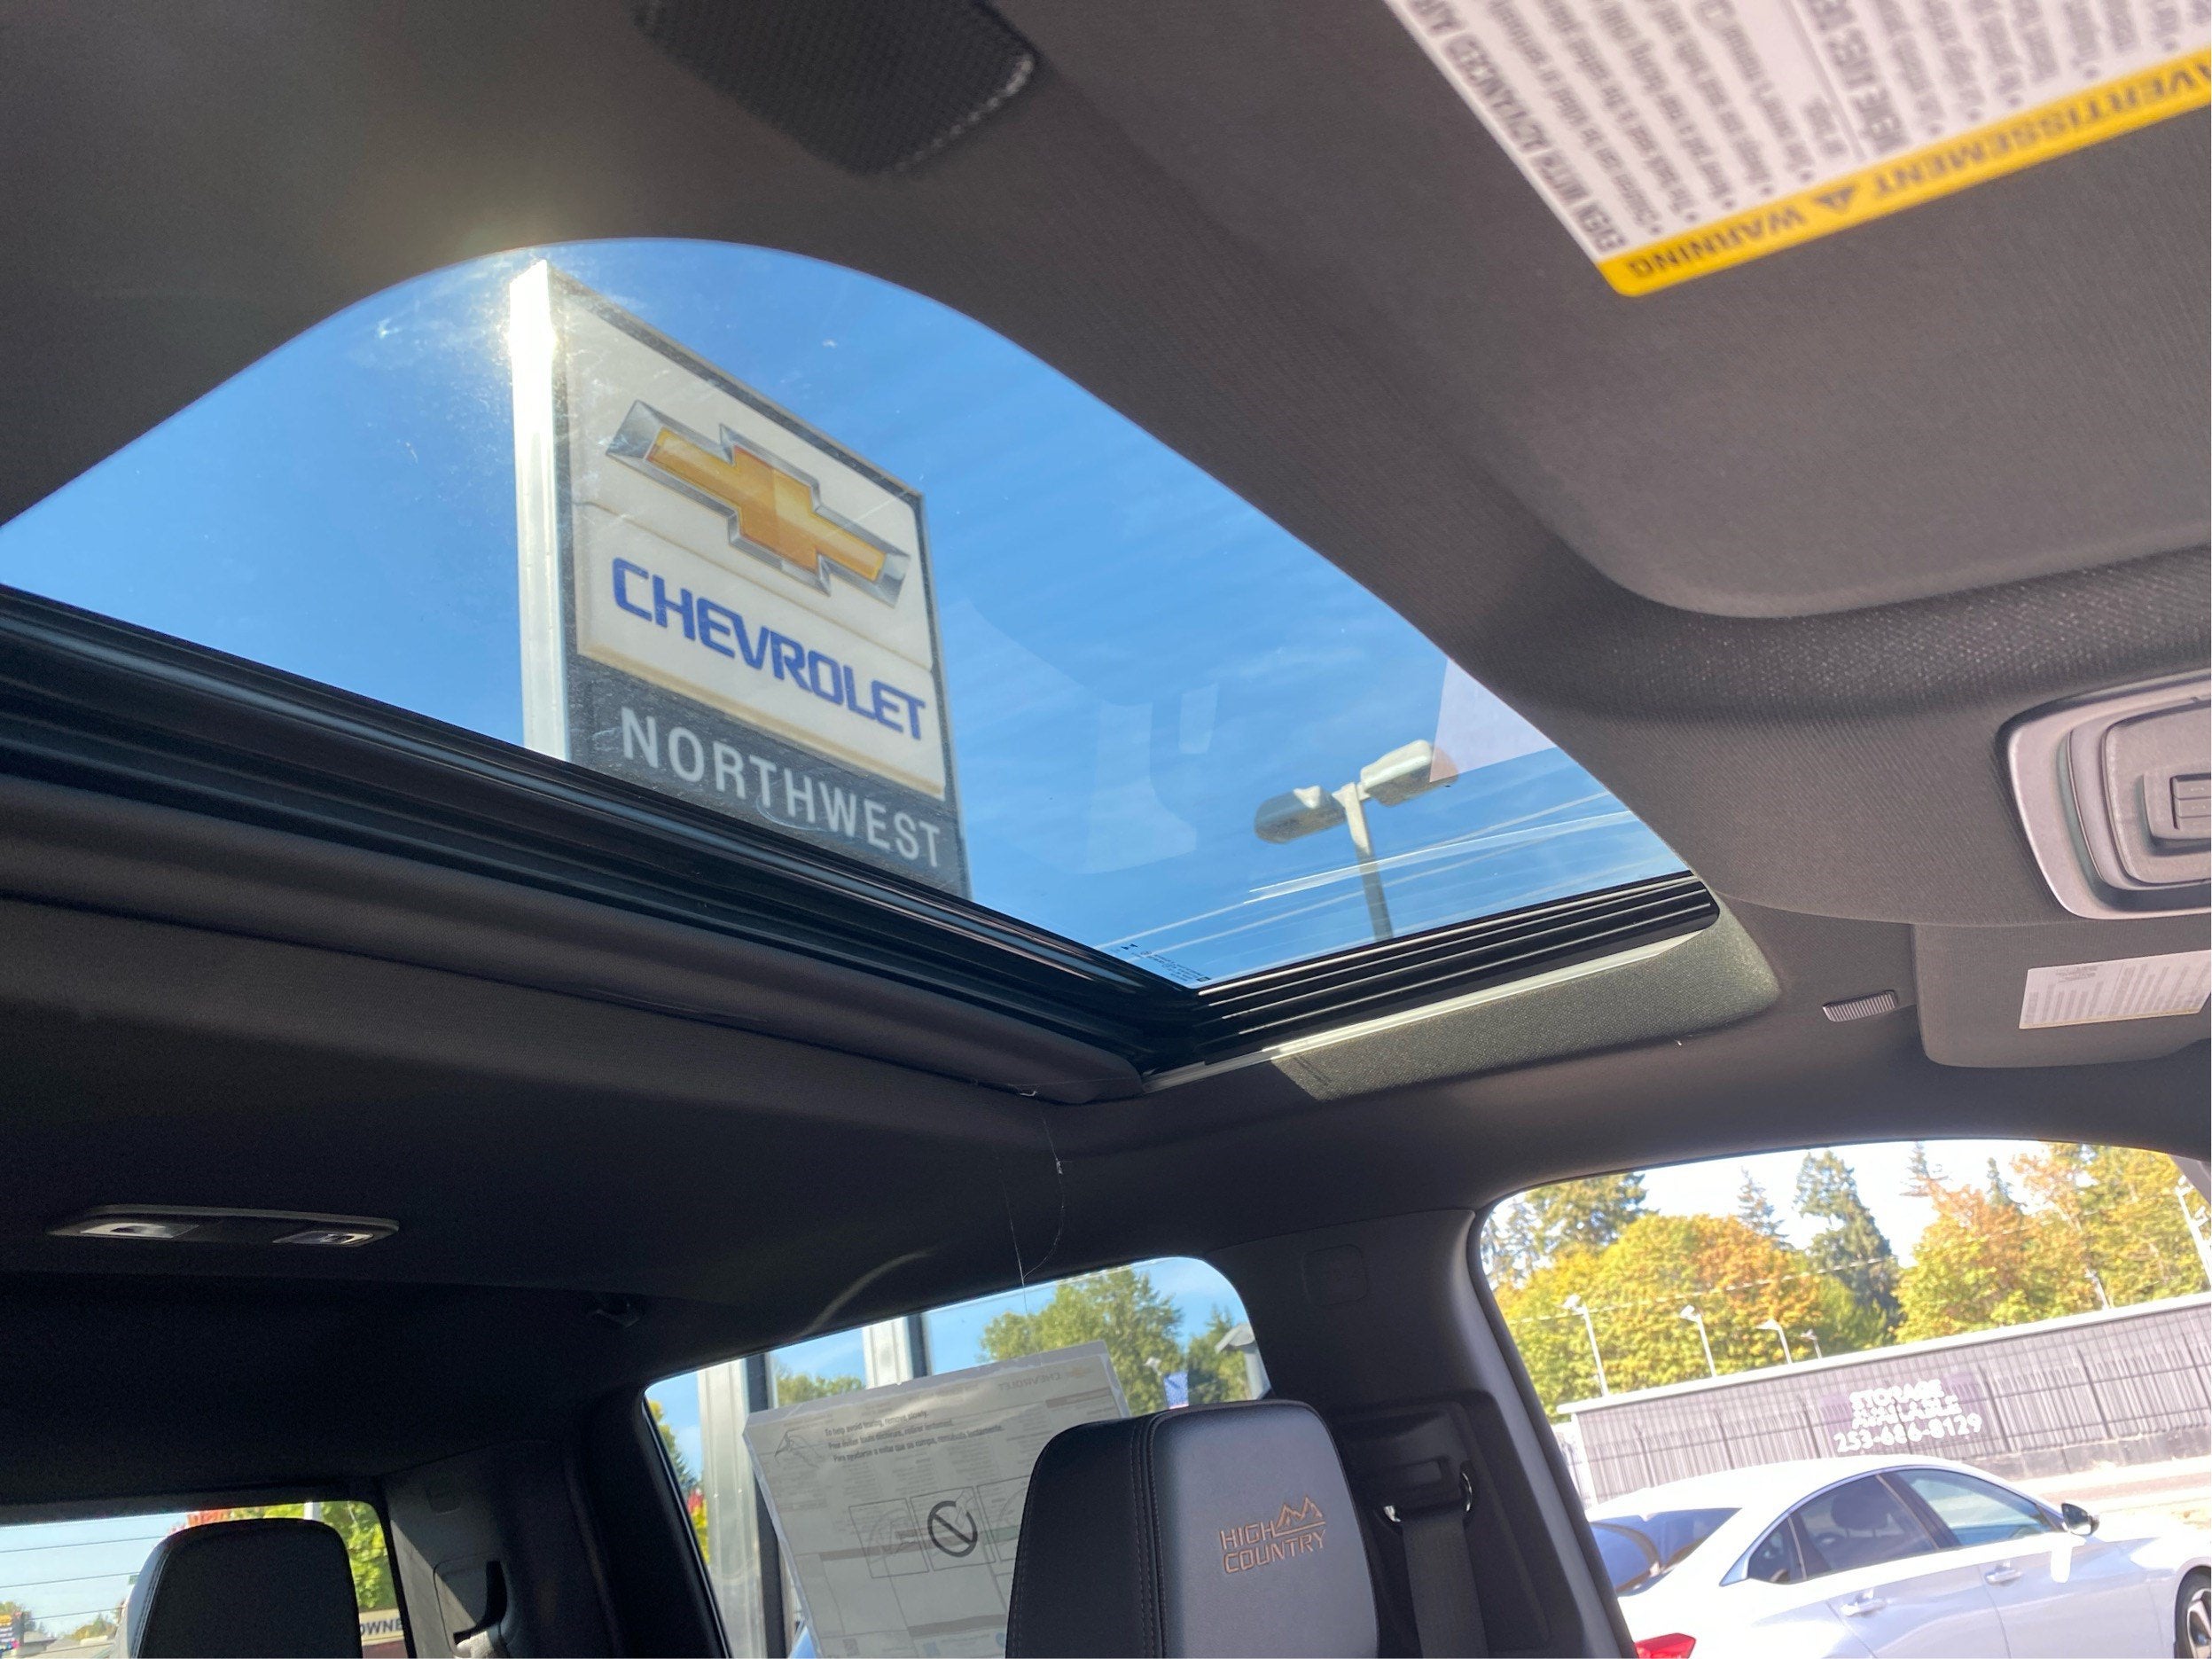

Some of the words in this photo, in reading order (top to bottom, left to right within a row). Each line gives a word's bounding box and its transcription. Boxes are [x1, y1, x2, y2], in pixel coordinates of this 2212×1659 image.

[1628, 206, 1805, 278] WARNING
[612, 557, 926, 741] CHEVROLET
[621, 708, 941, 869] NORTHWEST
[1219, 1519, 1277, 1551] HIGH
[1223, 1529, 1327, 1574] COUNTRY
